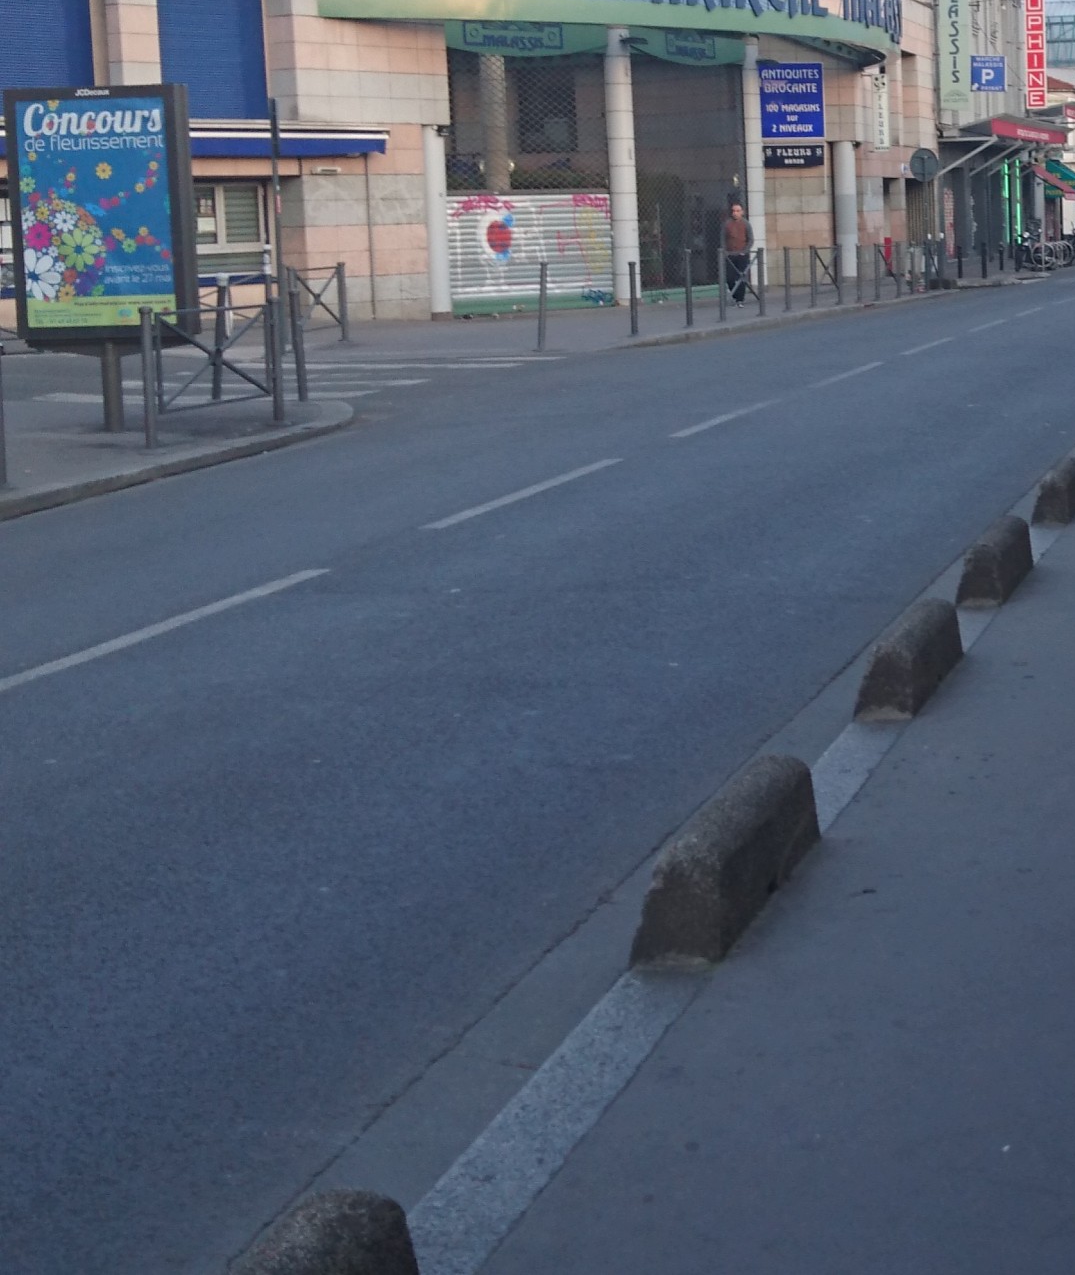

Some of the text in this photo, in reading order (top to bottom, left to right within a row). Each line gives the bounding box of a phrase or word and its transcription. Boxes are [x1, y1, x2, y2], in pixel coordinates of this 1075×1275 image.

[761, 68, 820, 80] ANTIQUITES
[981, 69, 995, 84] P
[75, 88, 110, 97] JCDecaux
[764, 82, 818, 94] BROCANTE
[766, 104, 821, 113] 100 MAGASINS
[23, 103, 163, 138] Concours
[772, 124, 814, 133] 2 NIVEAUX
[24, 134, 164, 152] de fleurissement
